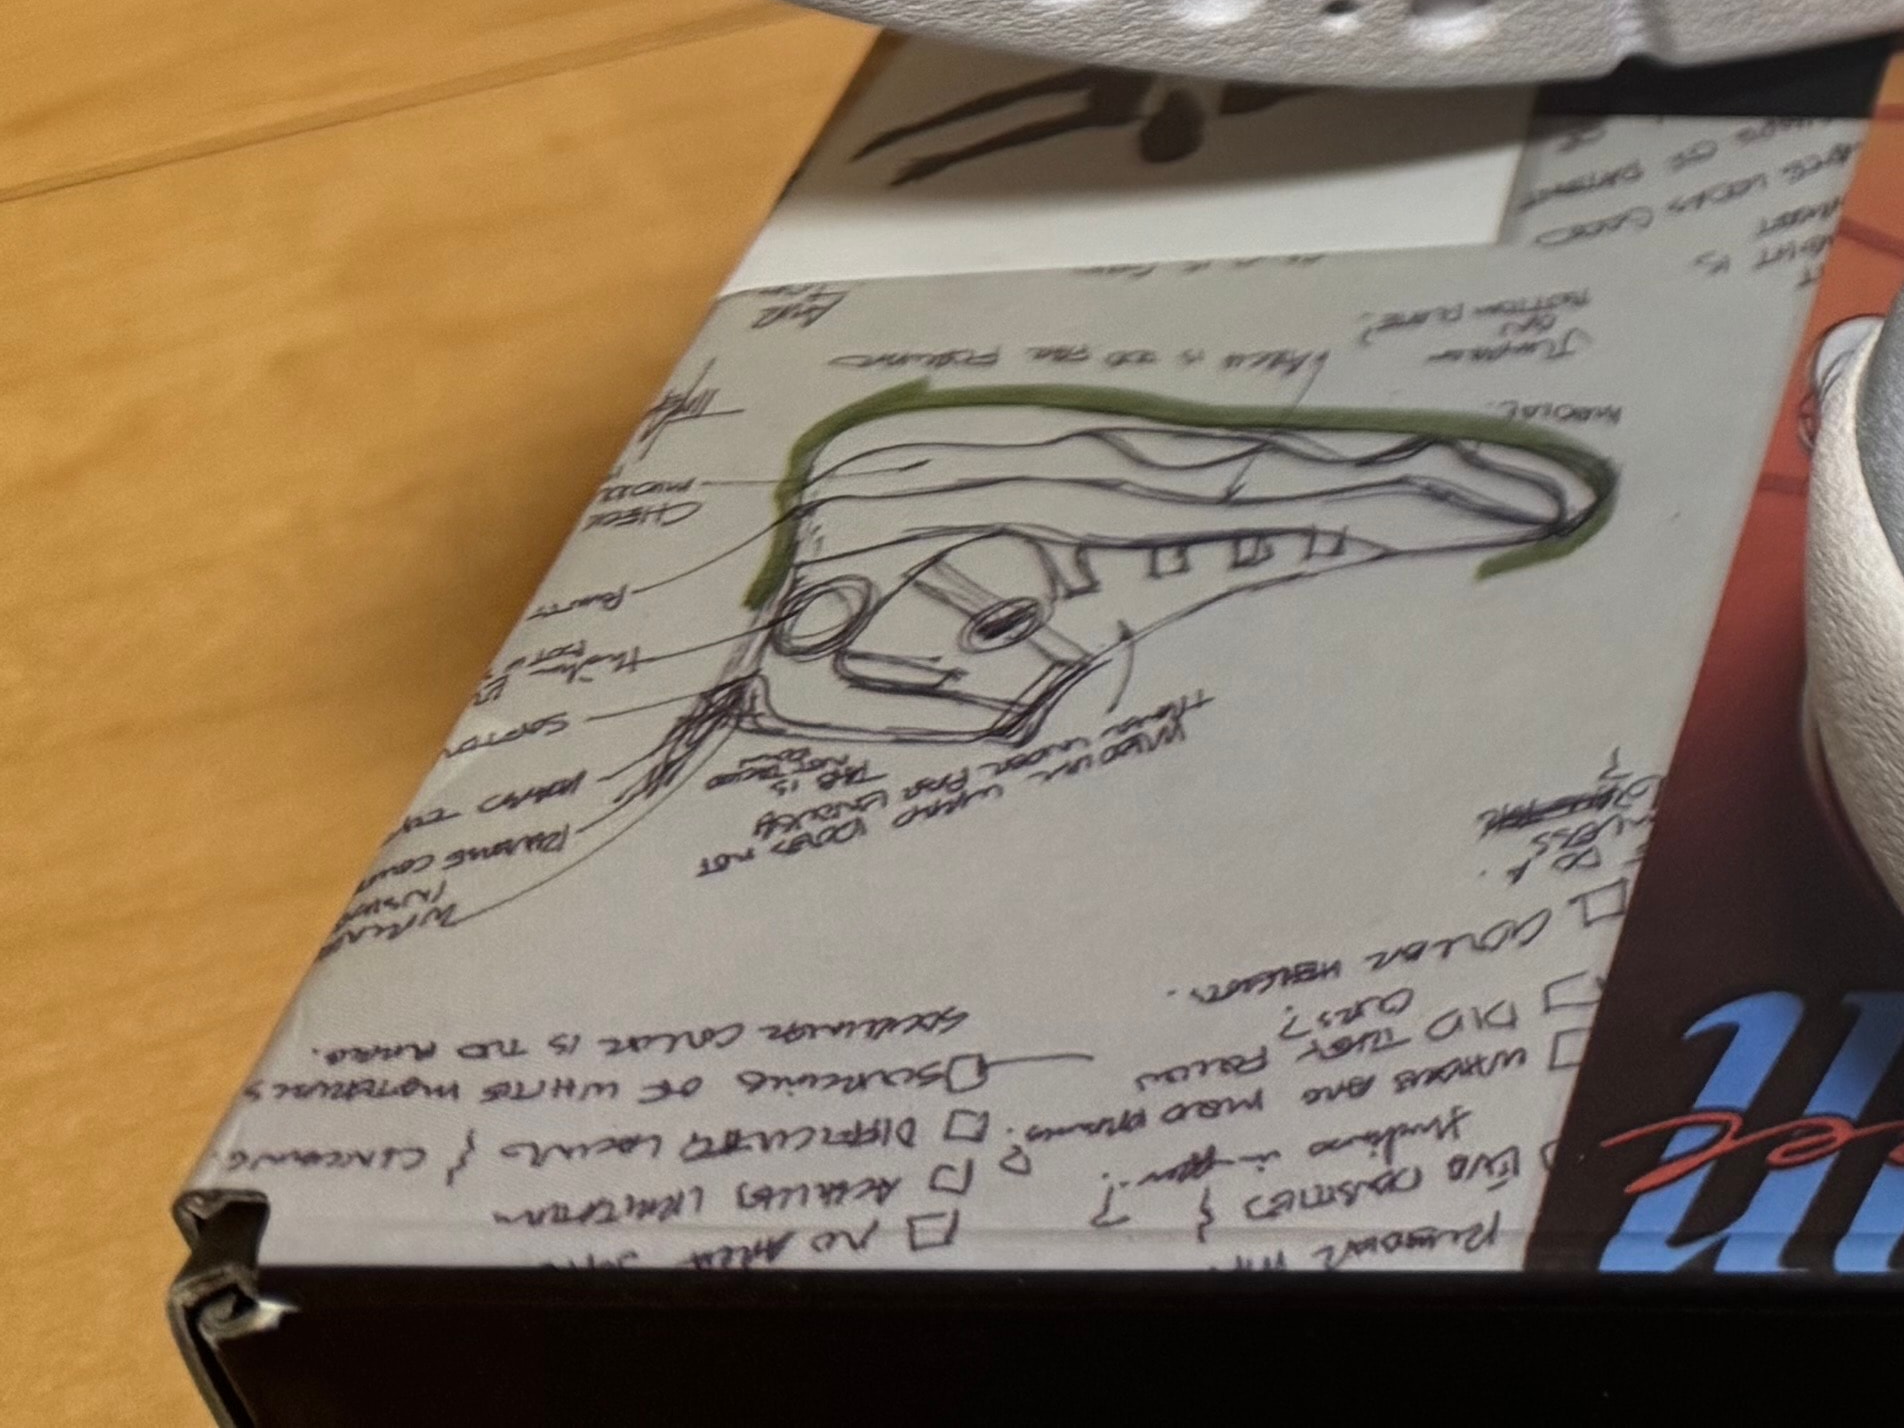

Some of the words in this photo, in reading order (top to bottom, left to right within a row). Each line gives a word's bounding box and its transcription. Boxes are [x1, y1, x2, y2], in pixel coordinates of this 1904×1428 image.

[695, 848, 754, 877] NOT
[1424, 1000, 1517, 1042] DID
[546, 1032, 581, 1058] IS
[476, 1075, 619, 1105] WHITE
[637, 1075, 703, 1105] OF
